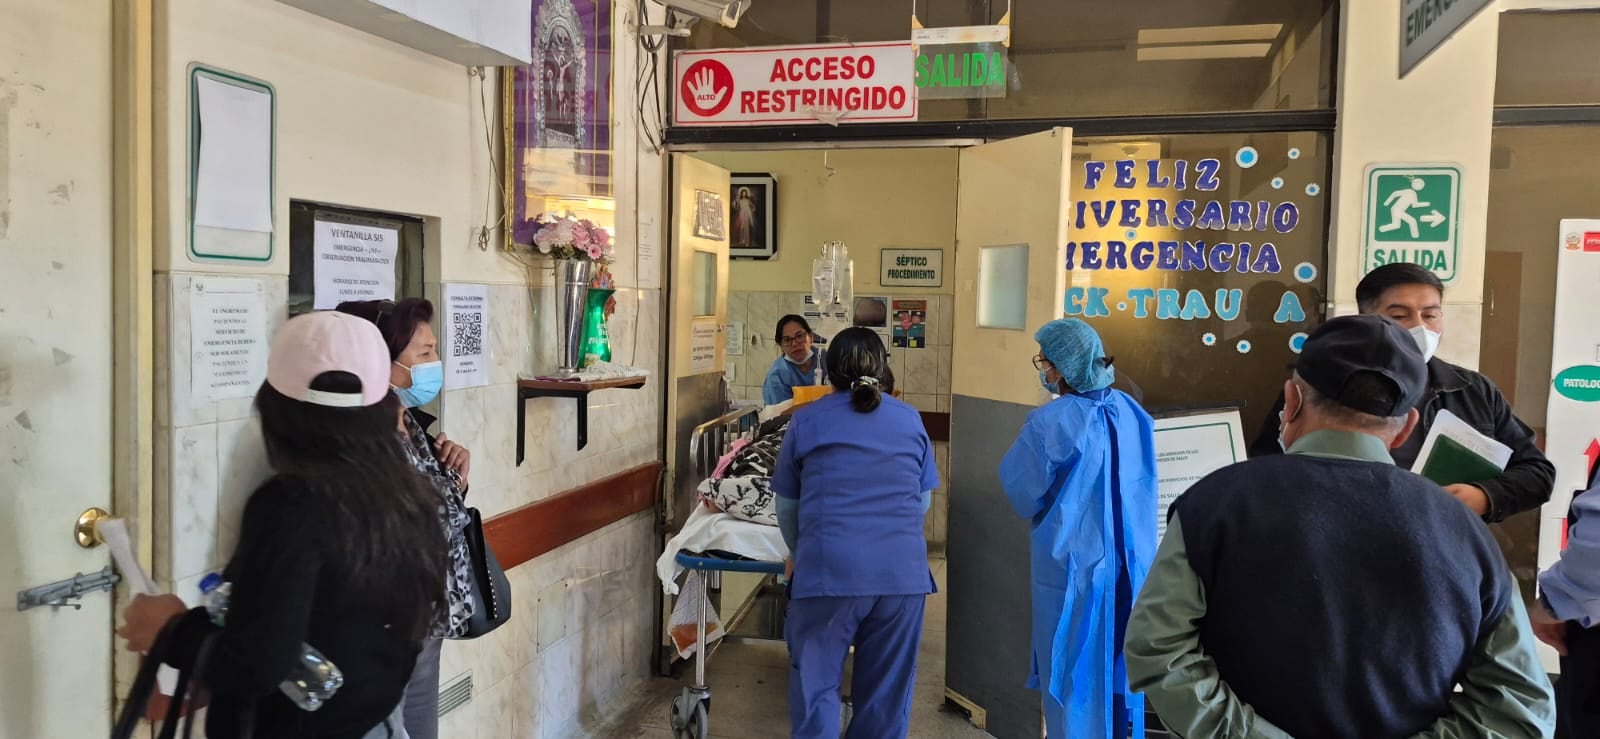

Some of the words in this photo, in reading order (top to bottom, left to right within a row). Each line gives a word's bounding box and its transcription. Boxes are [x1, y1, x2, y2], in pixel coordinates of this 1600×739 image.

[770, 54, 875, 83] ACCESO
[914, 52, 1005, 89] SALIDA
[740, 85, 906, 114] RESTRINGIDO
[1084, 158, 1221, 191] FELIZ
[331, 228, 373, 241] VENTANILLA
[374, 233, 384, 242] SIS
[333, 244, 364, 253] EMERGENCIA
[1373, 248, 1447, 271] SALIDA
[896, 254, 927, 267] SÉPTICO
[887, 268, 935, 280] PROCEDIMIENTO
